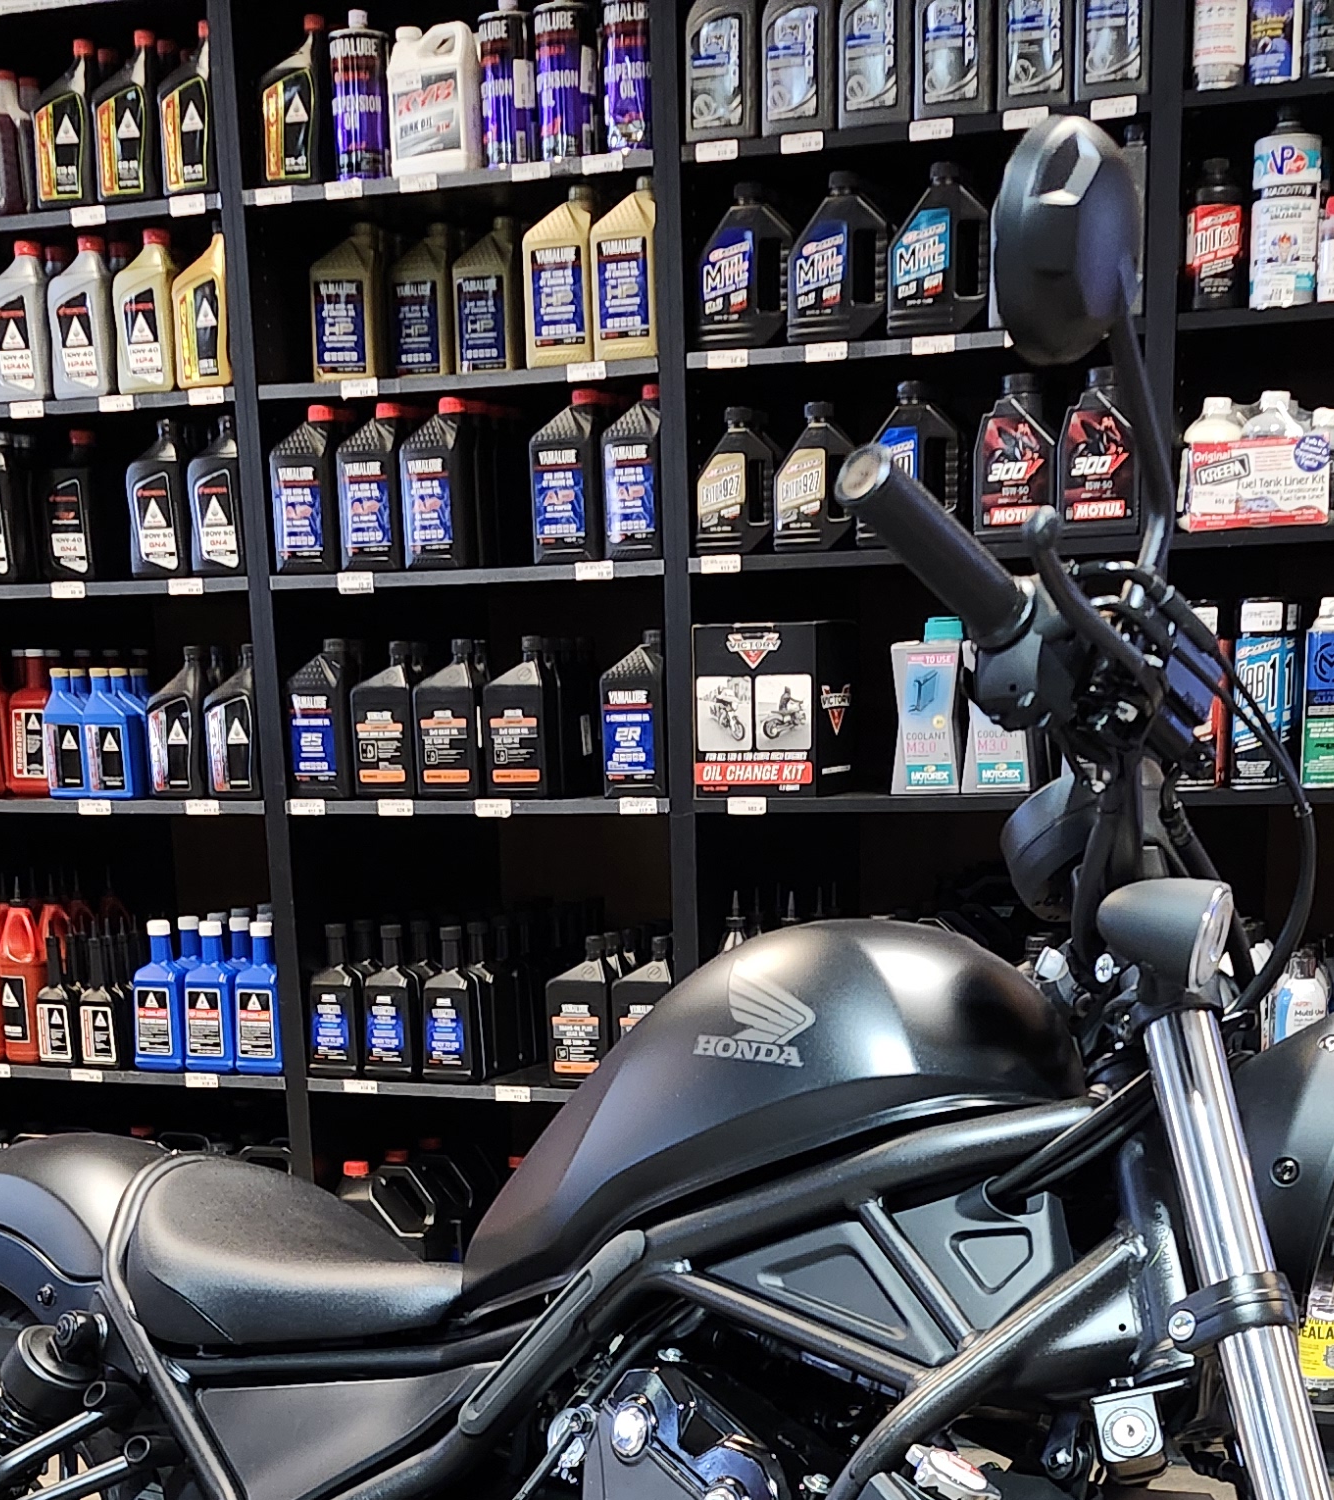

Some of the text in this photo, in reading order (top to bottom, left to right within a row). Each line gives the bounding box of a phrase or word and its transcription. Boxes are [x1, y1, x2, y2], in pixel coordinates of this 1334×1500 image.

[1198, 459, 1247, 484] KREEM
[990, 506, 1031, 525] MOTU
[1073, 500, 1124, 519] MOTUL
[728, 640, 781, 650] VICTORY
[925, 654, 952, 664] TO USE
[906, 730, 947, 742] COOLANT
[702, 763, 806, 782] OIL CHANGE KIT
[692, 1034, 805, 1068] HONDA
